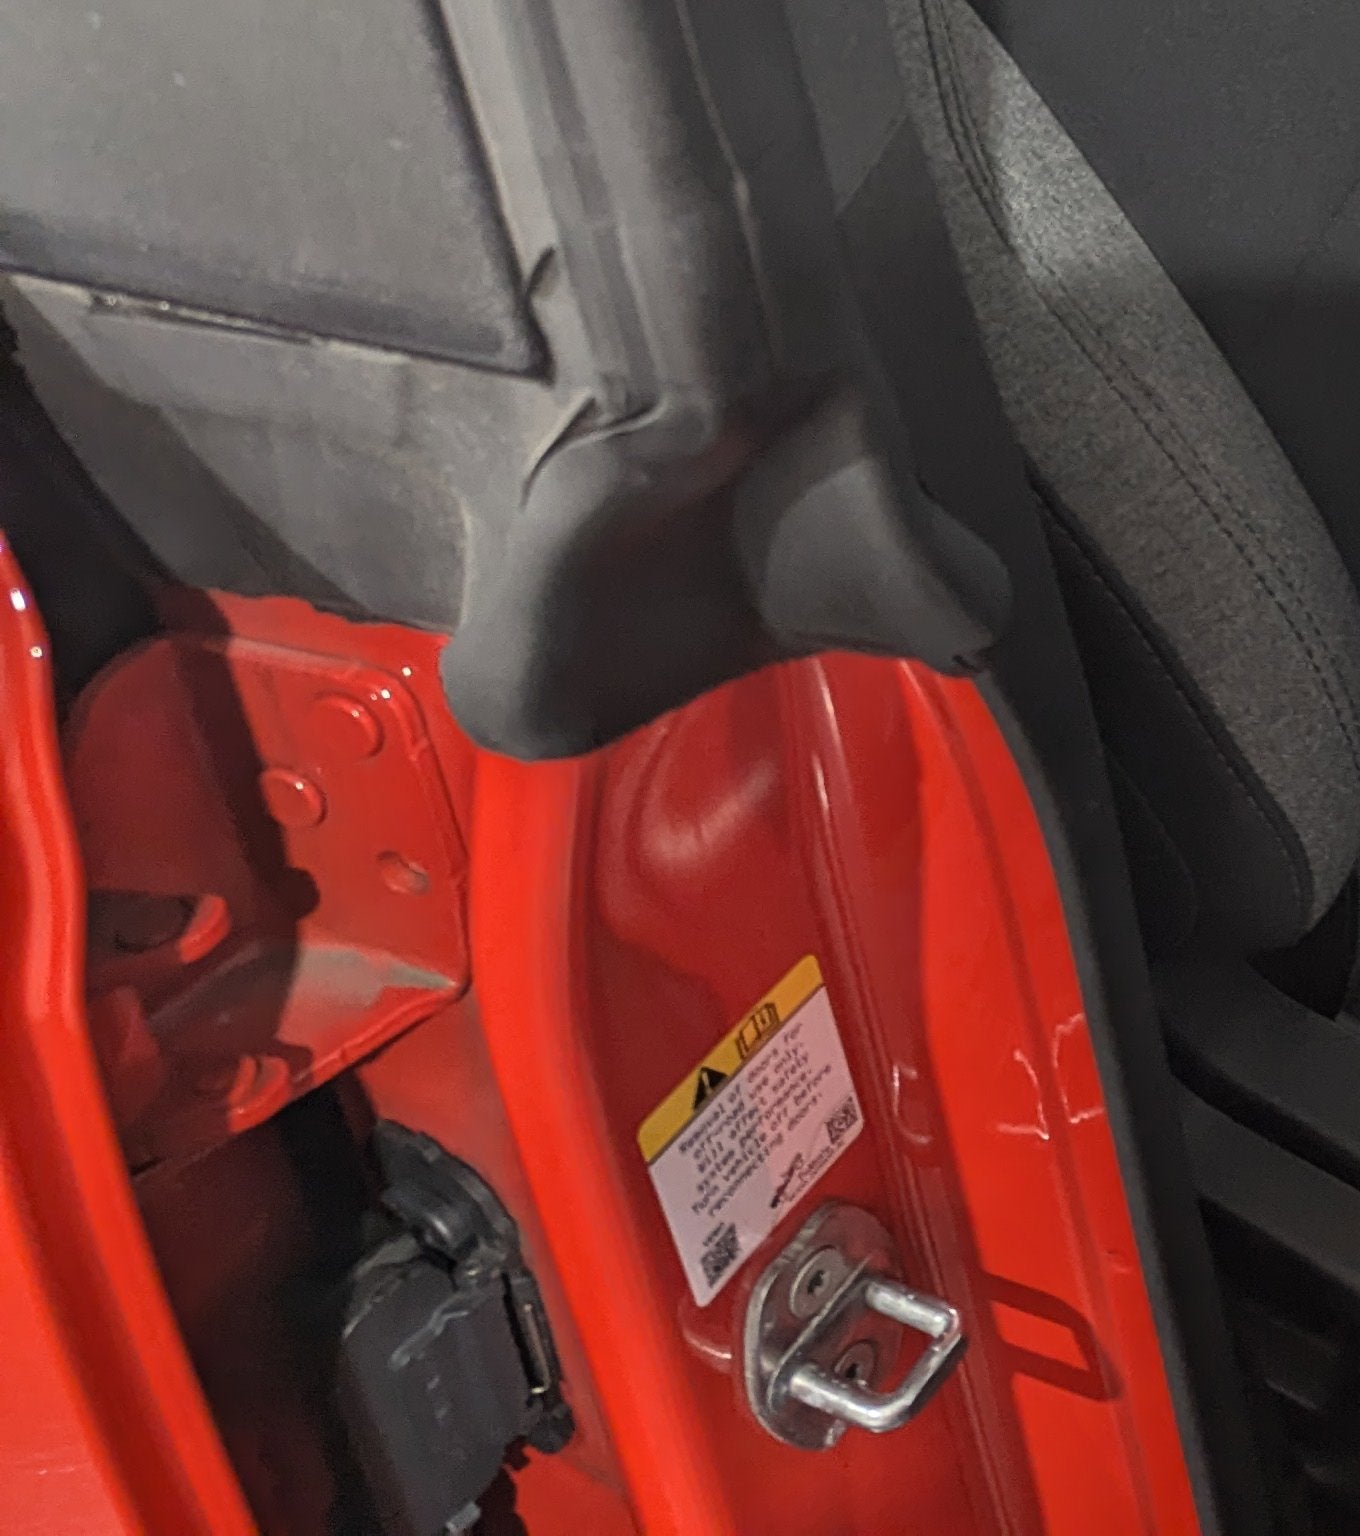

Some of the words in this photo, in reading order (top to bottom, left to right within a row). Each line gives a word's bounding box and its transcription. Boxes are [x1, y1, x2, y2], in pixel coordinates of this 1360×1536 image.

[679, 1104, 724, 1153] Removal
[728, 1084, 739, 1102] of
[748, 1048, 778, 1082] doors
[772, 1053, 808, 1091] safety
[723, 1132, 766, 1181] vehicle
[770, 1107, 787, 1131] off
[793, 1064, 831, 1105] before
[696, 1149, 734, 1192] system
